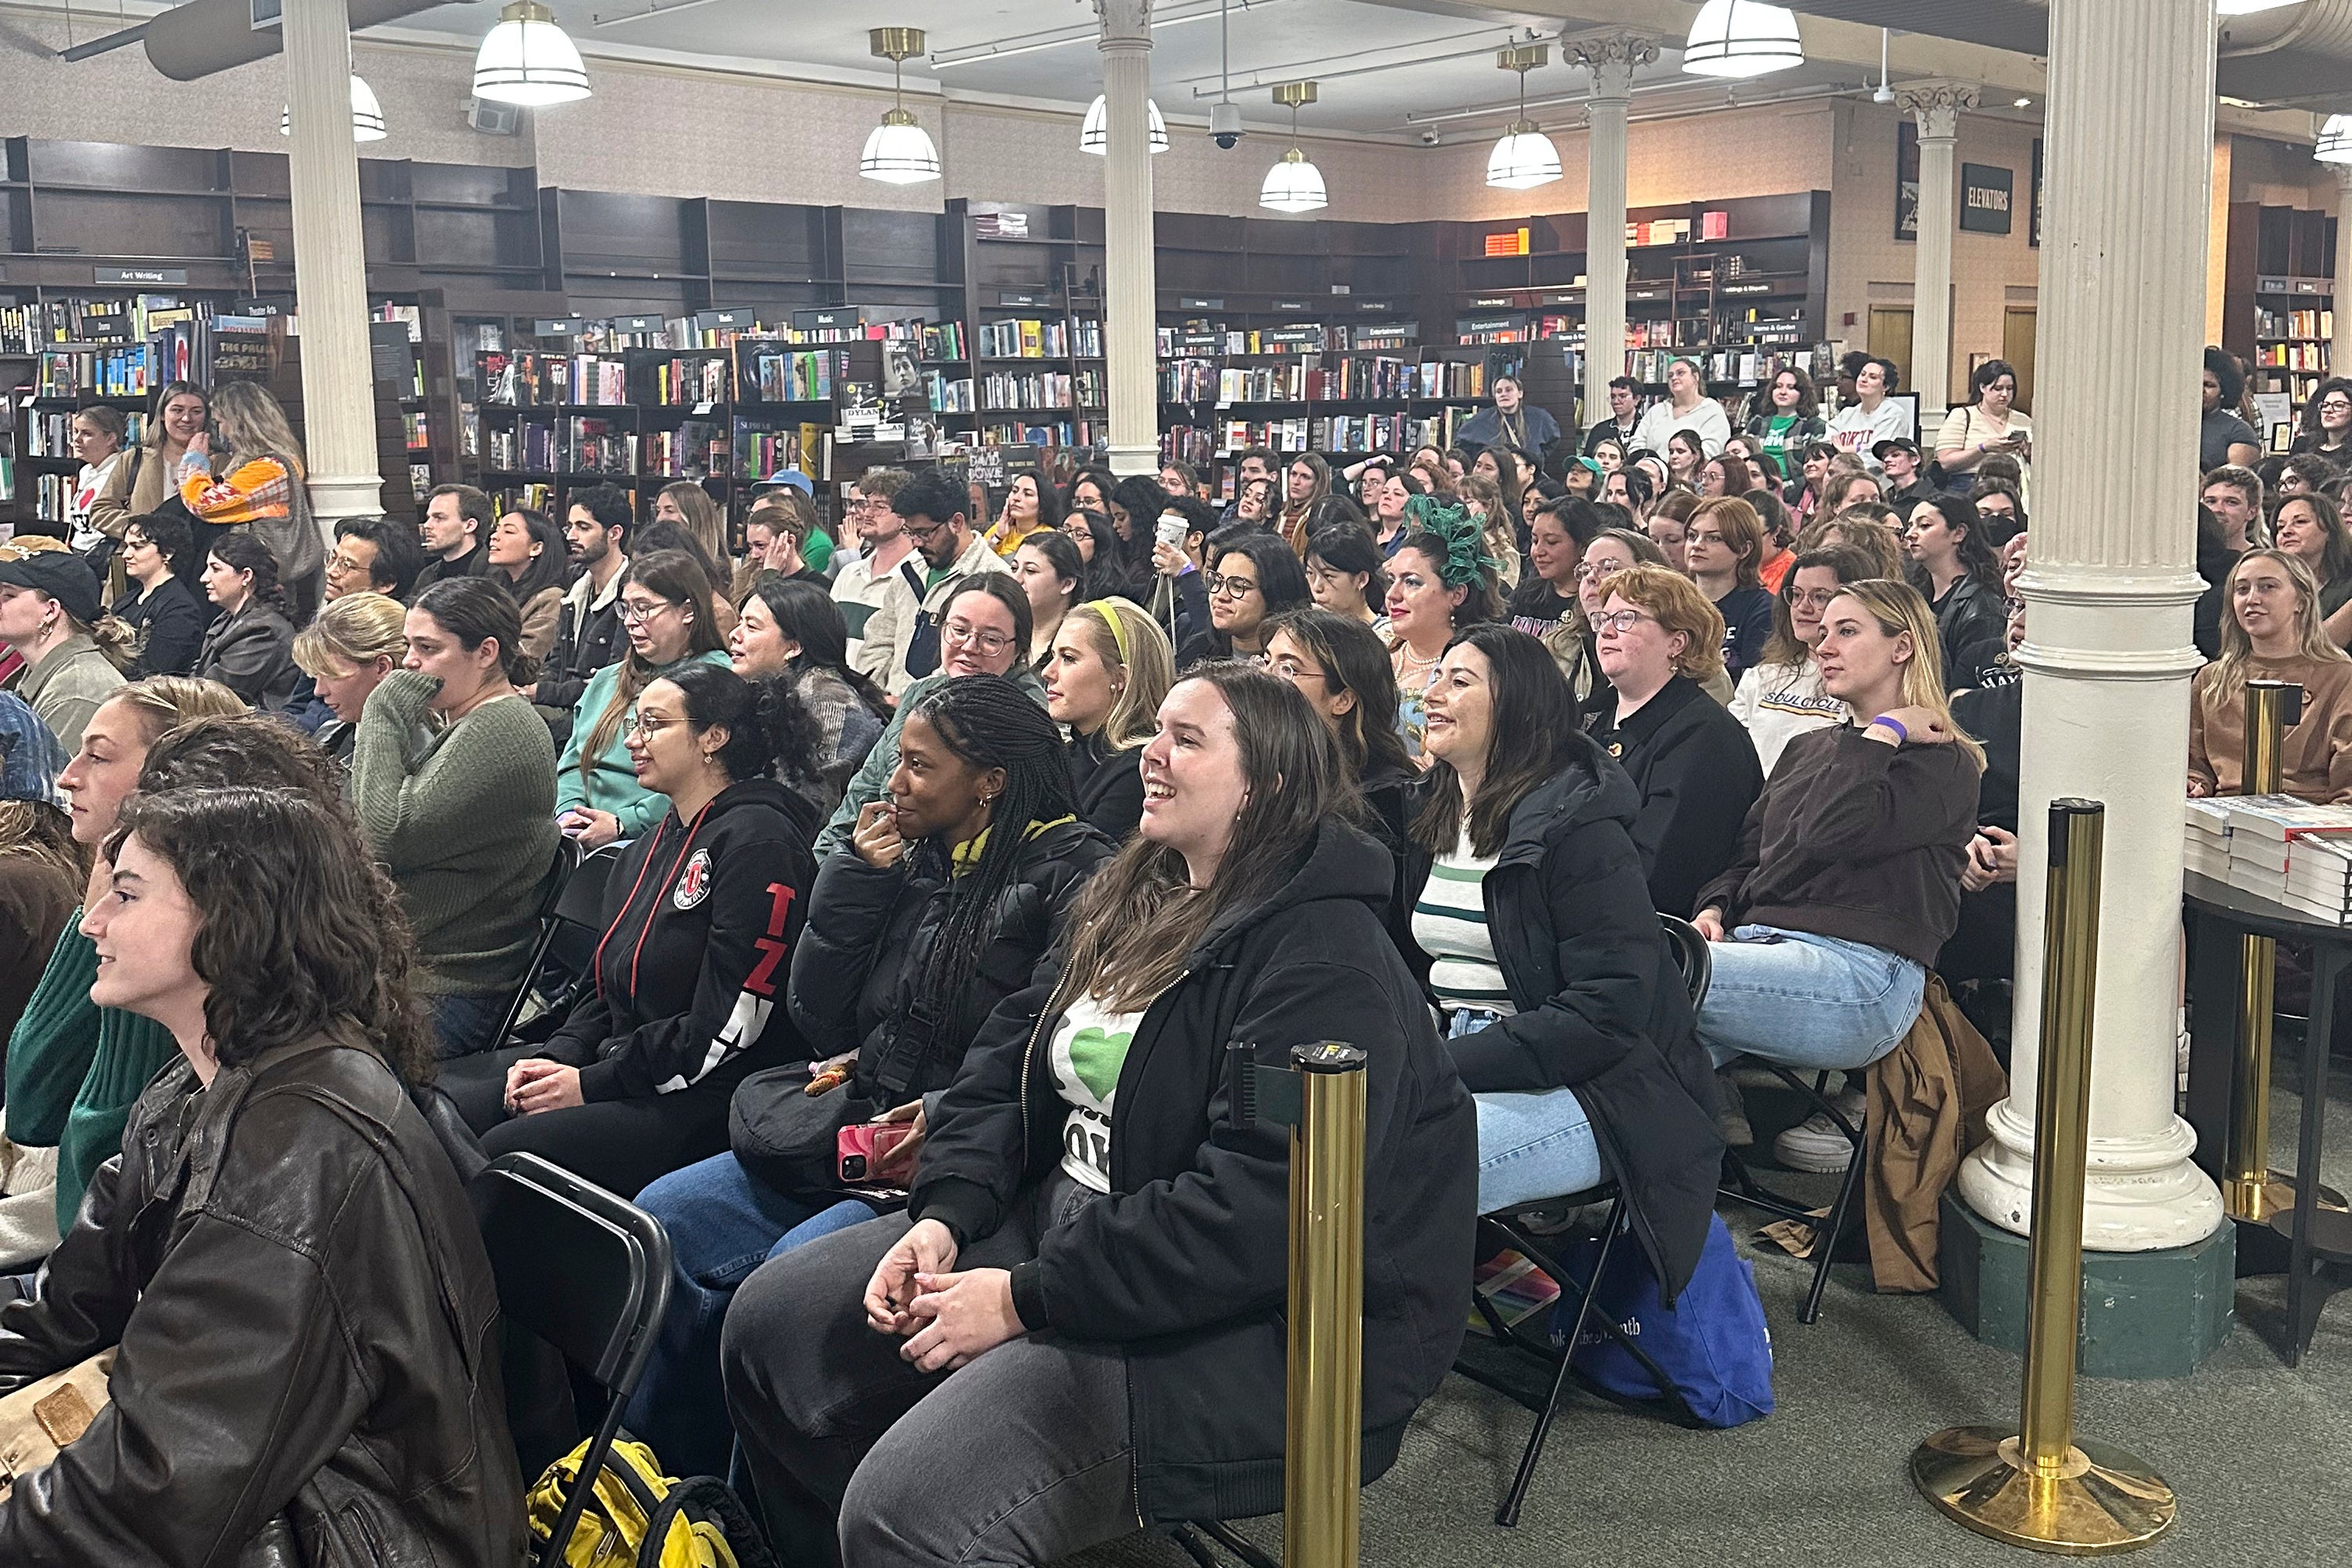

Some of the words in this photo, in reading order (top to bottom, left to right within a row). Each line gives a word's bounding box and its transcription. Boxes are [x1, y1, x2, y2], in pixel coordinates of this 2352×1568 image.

[1968, 187, 2009, 212] ELEVATORS
[120, 271, 134, 280] Art
[135, 271, 163, 281] Writing
[817, 314, 833, 324] Music
[1471, 321, 1508, 331] Entertainment
[1369, 327, 1405, 336] Entertainment
[220, 342, 239, 352] THE
[848, 409, 878, 418] DYLAN
[1764, 691, 1846, 713] SOULCYCLE
